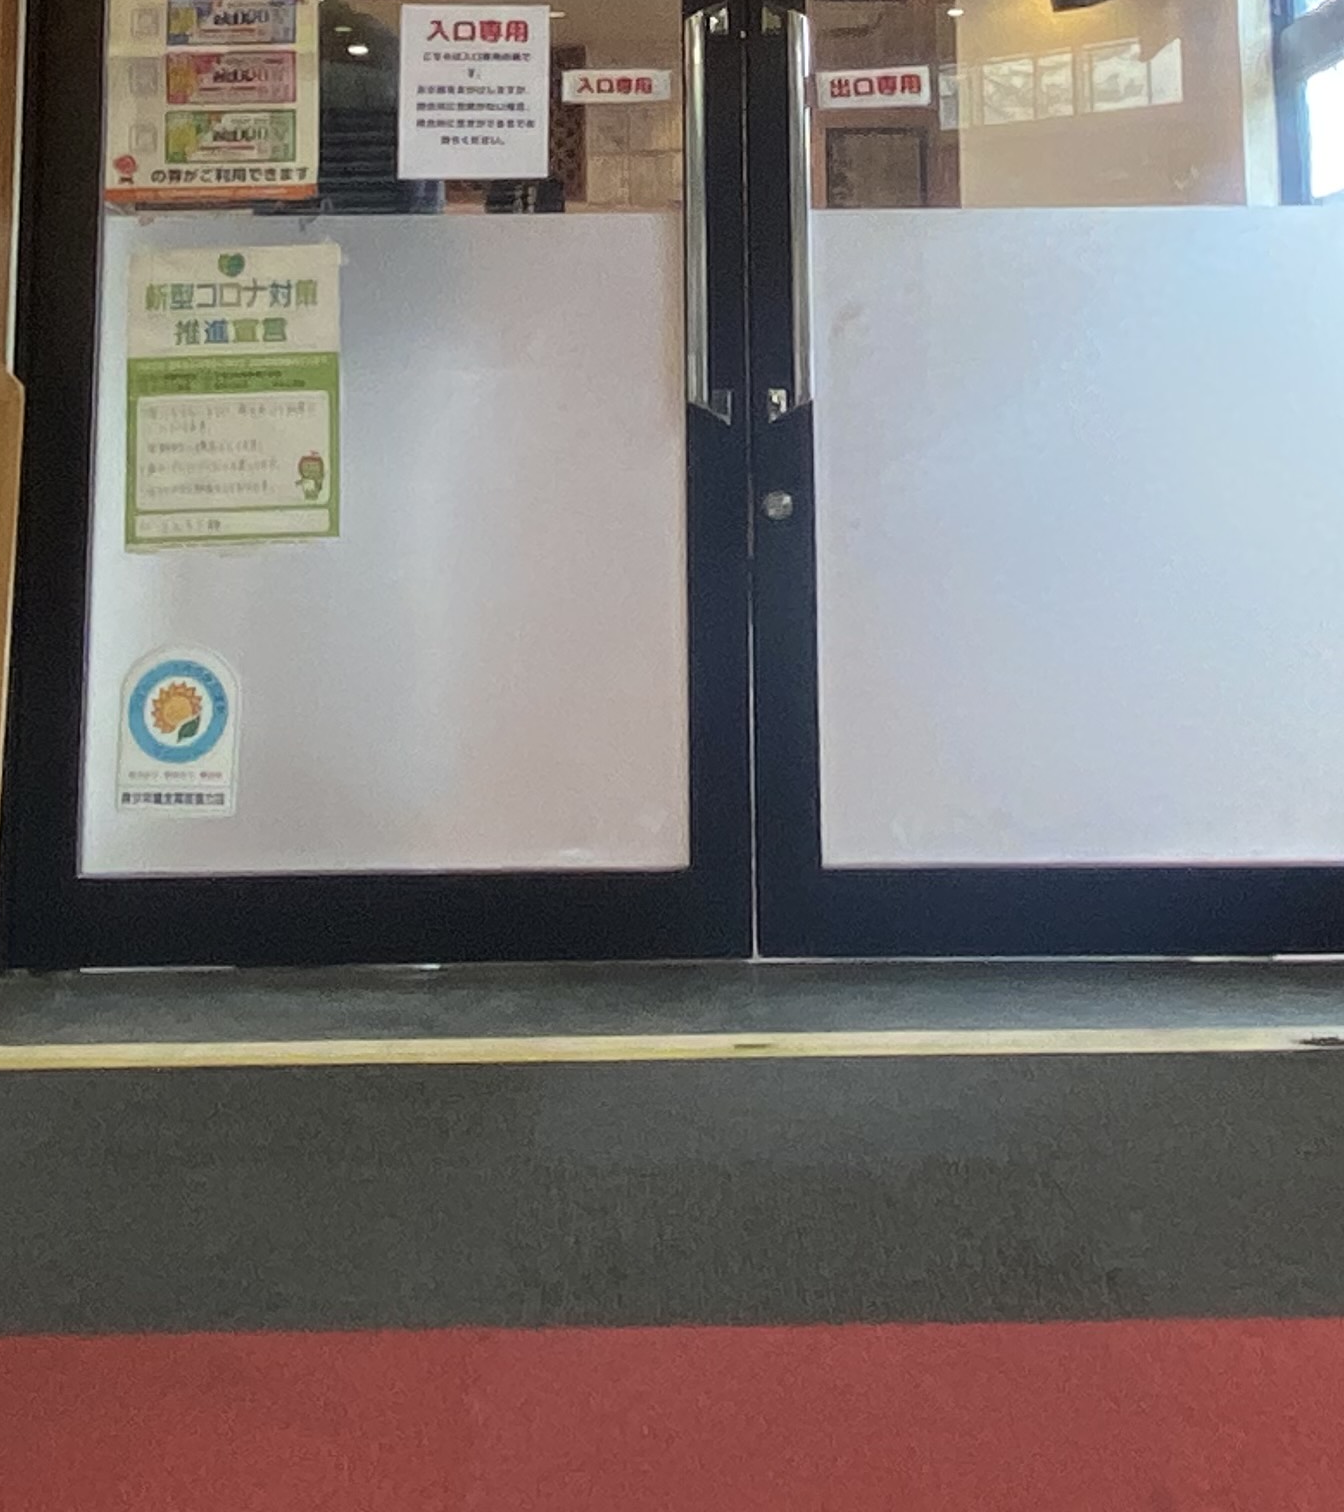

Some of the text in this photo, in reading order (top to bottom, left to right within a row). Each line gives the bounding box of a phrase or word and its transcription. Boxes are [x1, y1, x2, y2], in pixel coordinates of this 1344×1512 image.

[427, 19, 529, 43] 入口専用
[576, 76, 654, 95] 入口専用
[829, 74, 923, 99] 出口専用
